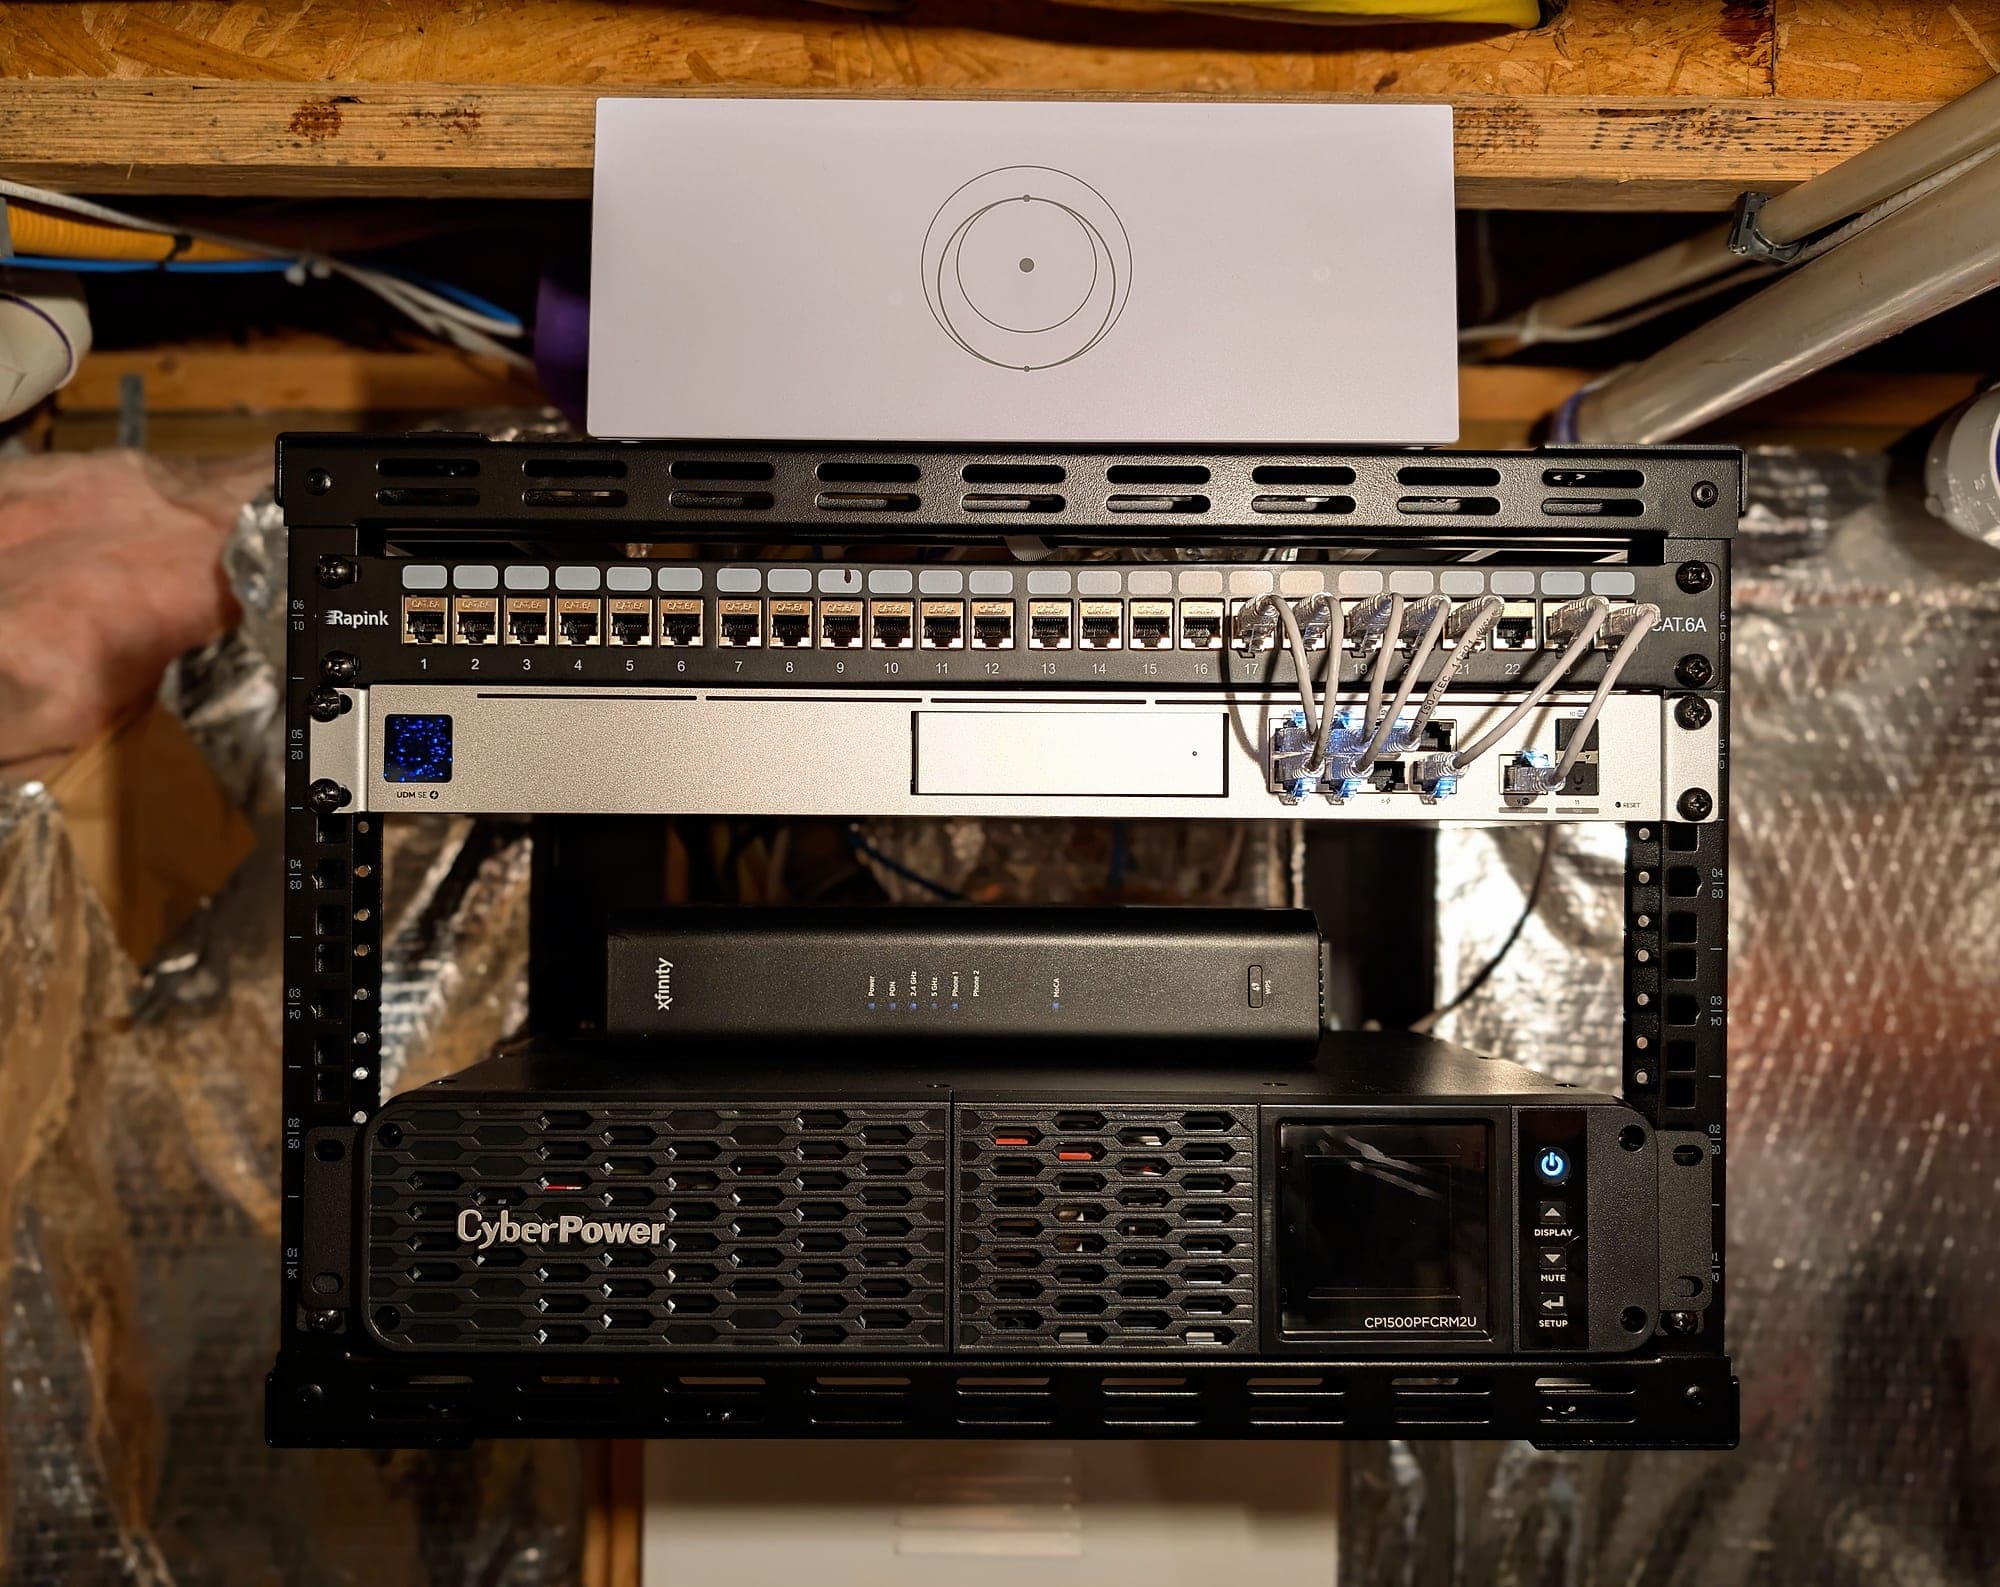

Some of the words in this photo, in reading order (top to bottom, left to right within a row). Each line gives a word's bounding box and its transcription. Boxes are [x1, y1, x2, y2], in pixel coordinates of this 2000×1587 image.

[292, 599, 304, 610] 06
[326, 609, 389, 629] Rapink
[1719, 611, 1726, 621] 6
[1719, 632, 1726, 642] 0
[420, 658, 427, 670] 1
[471, 658, 480, 670] 2
[522, 658, 531, 671] 3
[574, 659, 582, 671] 4
[625, 659, 634, 672] 5
[677, 660, 686, 672] 6
[735, 661, 743, 673] 7
[785, 661, 794, 673] 8
[836, 661, 845, 674] 9
[884, 662, 899, 674] 10
[935, 662, 948, 674] 11
[984, 662, 1000, 674] 12
[1041, 662, 1056, 675] 13
[1092, 663, 1106, 675] 14
[1142, 663, 1157, 675] 15
[1193, 663, 1208, 676] 16
[1244, 663, 1259, 675] 17
[1352, 663, 1368, 675] 19
[1454, 663, 1470, 675] 21
[1504, 663, 1521, 675] 22
[291, 729, 304, 739] 05
[1719, 739, 1726, 749] 5
[396, 791, 416, 799] UDM
[417, 791, 428, 799] SE
[1622, 801, 1641, 809] RESET
[289, 859, 302, 870] 04
[1711, 867, 1724, 878] 04
[910, 970, 918, 985] GHz
[656, 956, 674, 1012] xfinity
[867, 976, 876, 997] Power
[888, 981, 897, 997] PON
[952, 977, 960, 997] Phone
[973, 977, 981, 997] Phone
[288, 988, 301, 998] 03
[910, 986, 918, 997] 2.4
[1710, 995, 1723, 1006] 03
[287, 1117, 300, 1128] 02
[1708, 1124, 1721, 1134] 02
[457, 1209, 666, 1250] CyberPower
[1534, 1228, 1573, 1237] DISPLAY
[287, 1247, 298, 1258] 01
[1540, 1274, 1566, 1282] MUTE
[1364, 1316, 1477, 1329] CP1500PFCRM2U
[1538, 1320, 1568, 1328] SETUP
